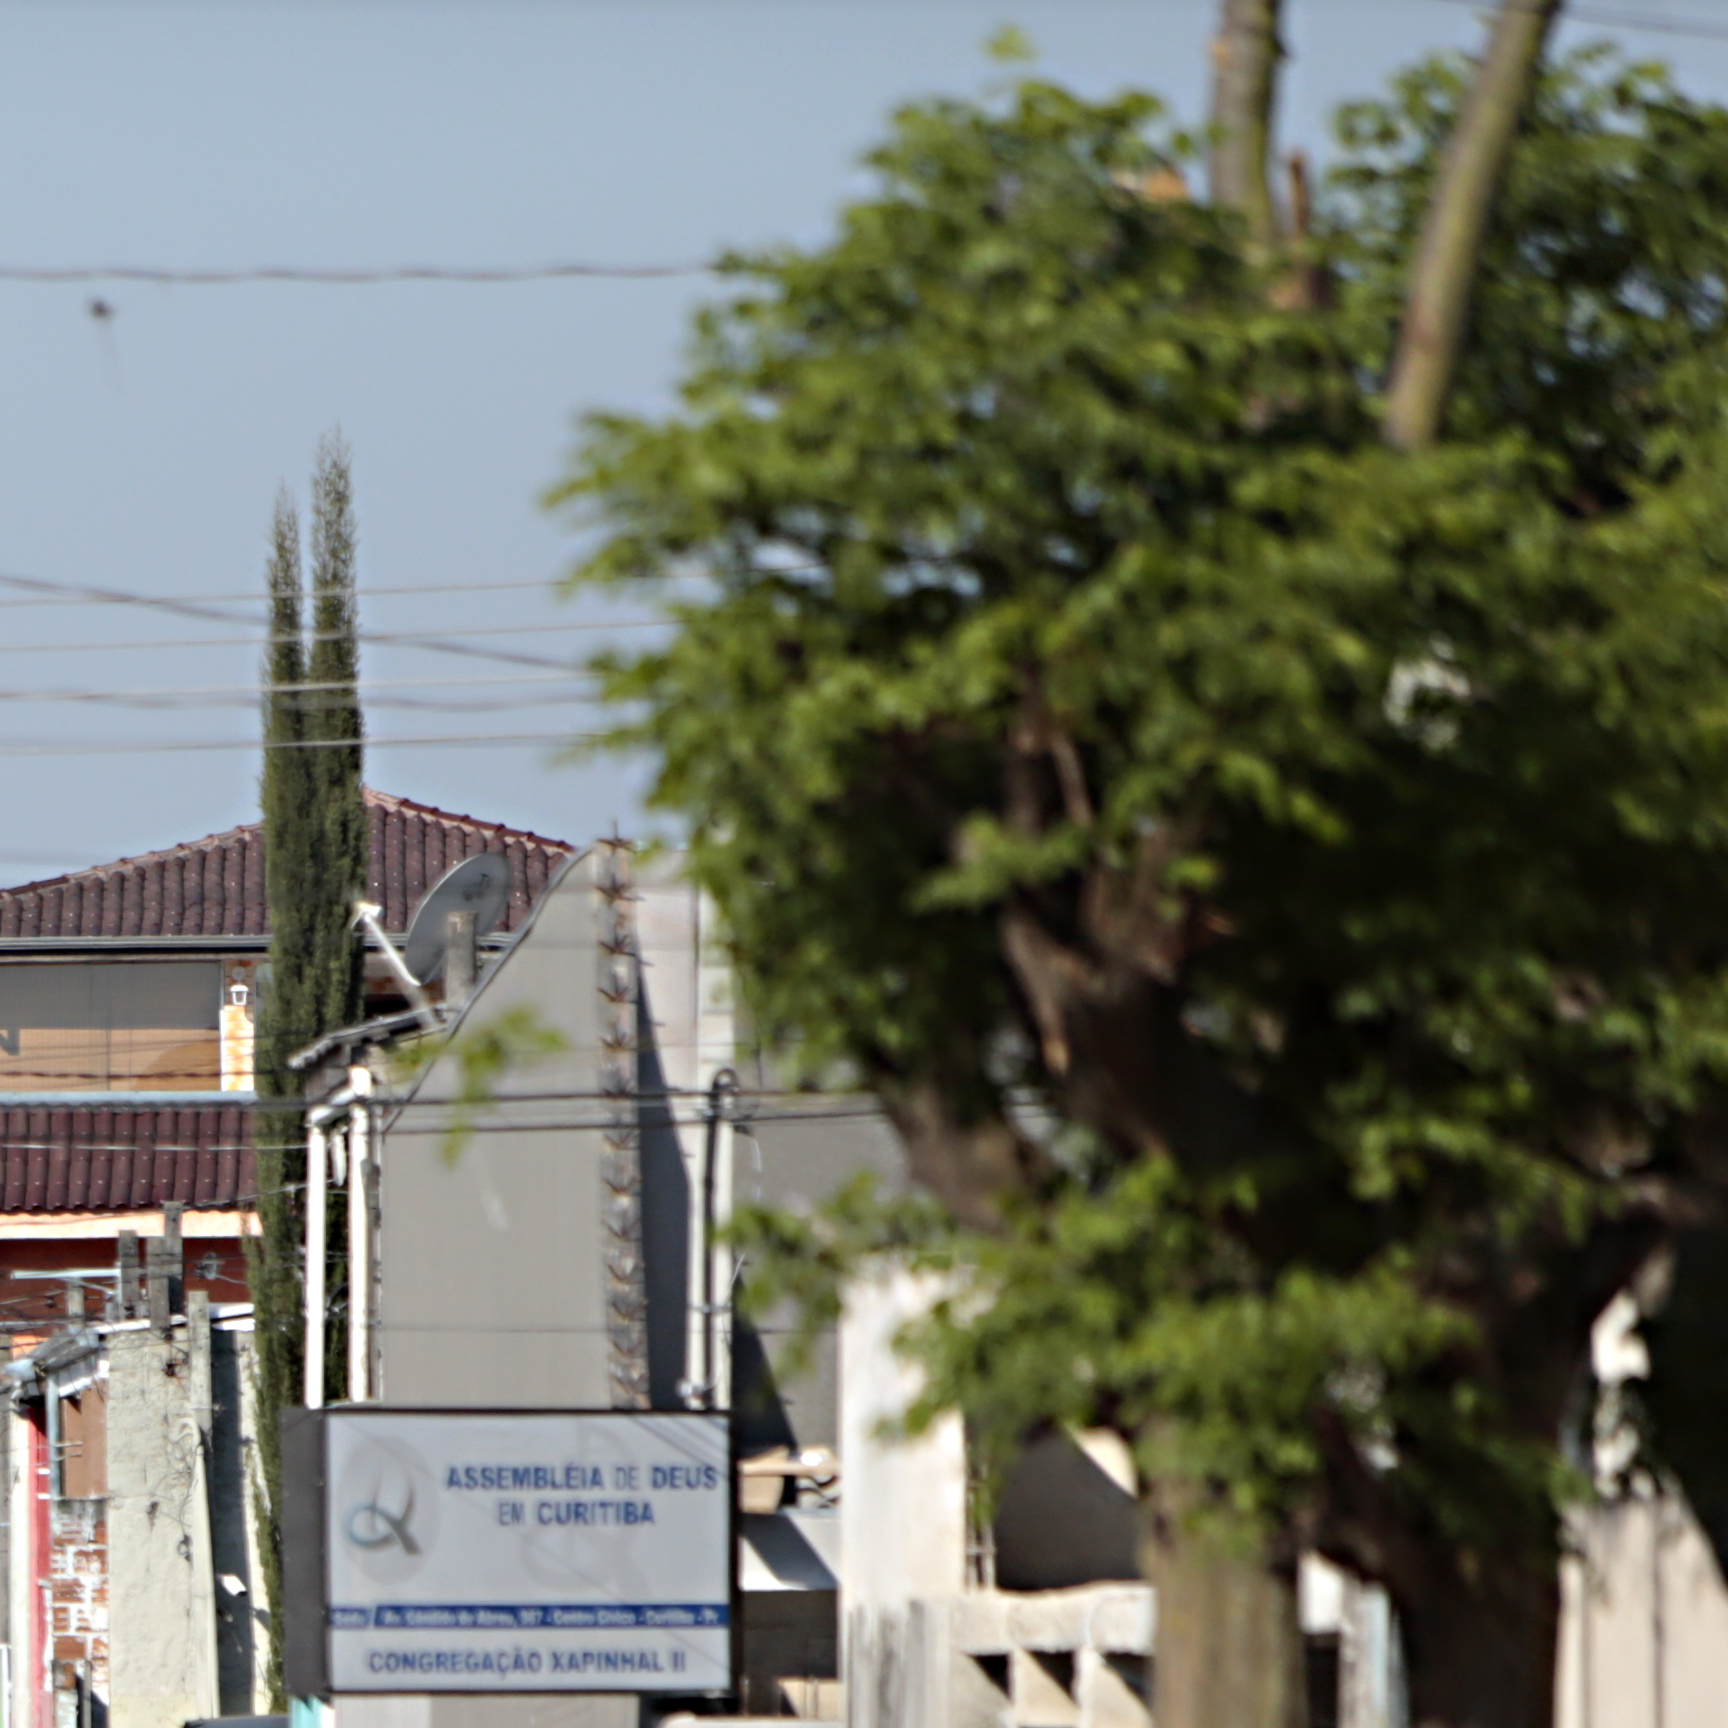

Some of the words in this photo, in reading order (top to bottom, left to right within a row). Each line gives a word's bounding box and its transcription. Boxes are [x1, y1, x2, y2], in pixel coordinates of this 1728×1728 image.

[447, 1461, 604, 1490] ASSEMBLÉIA
[616, 1466, 640, 1490] DE
[652, 1465, 718, 1490] DEUS
[499, 1501, 525, 1525] EM
[538, 1501, 655, 1525] CURITIBA
[369, 1646, 543, 1679] CONGREGAÇÃO
[551, 1651, 664, 1673] XAPINHAL
